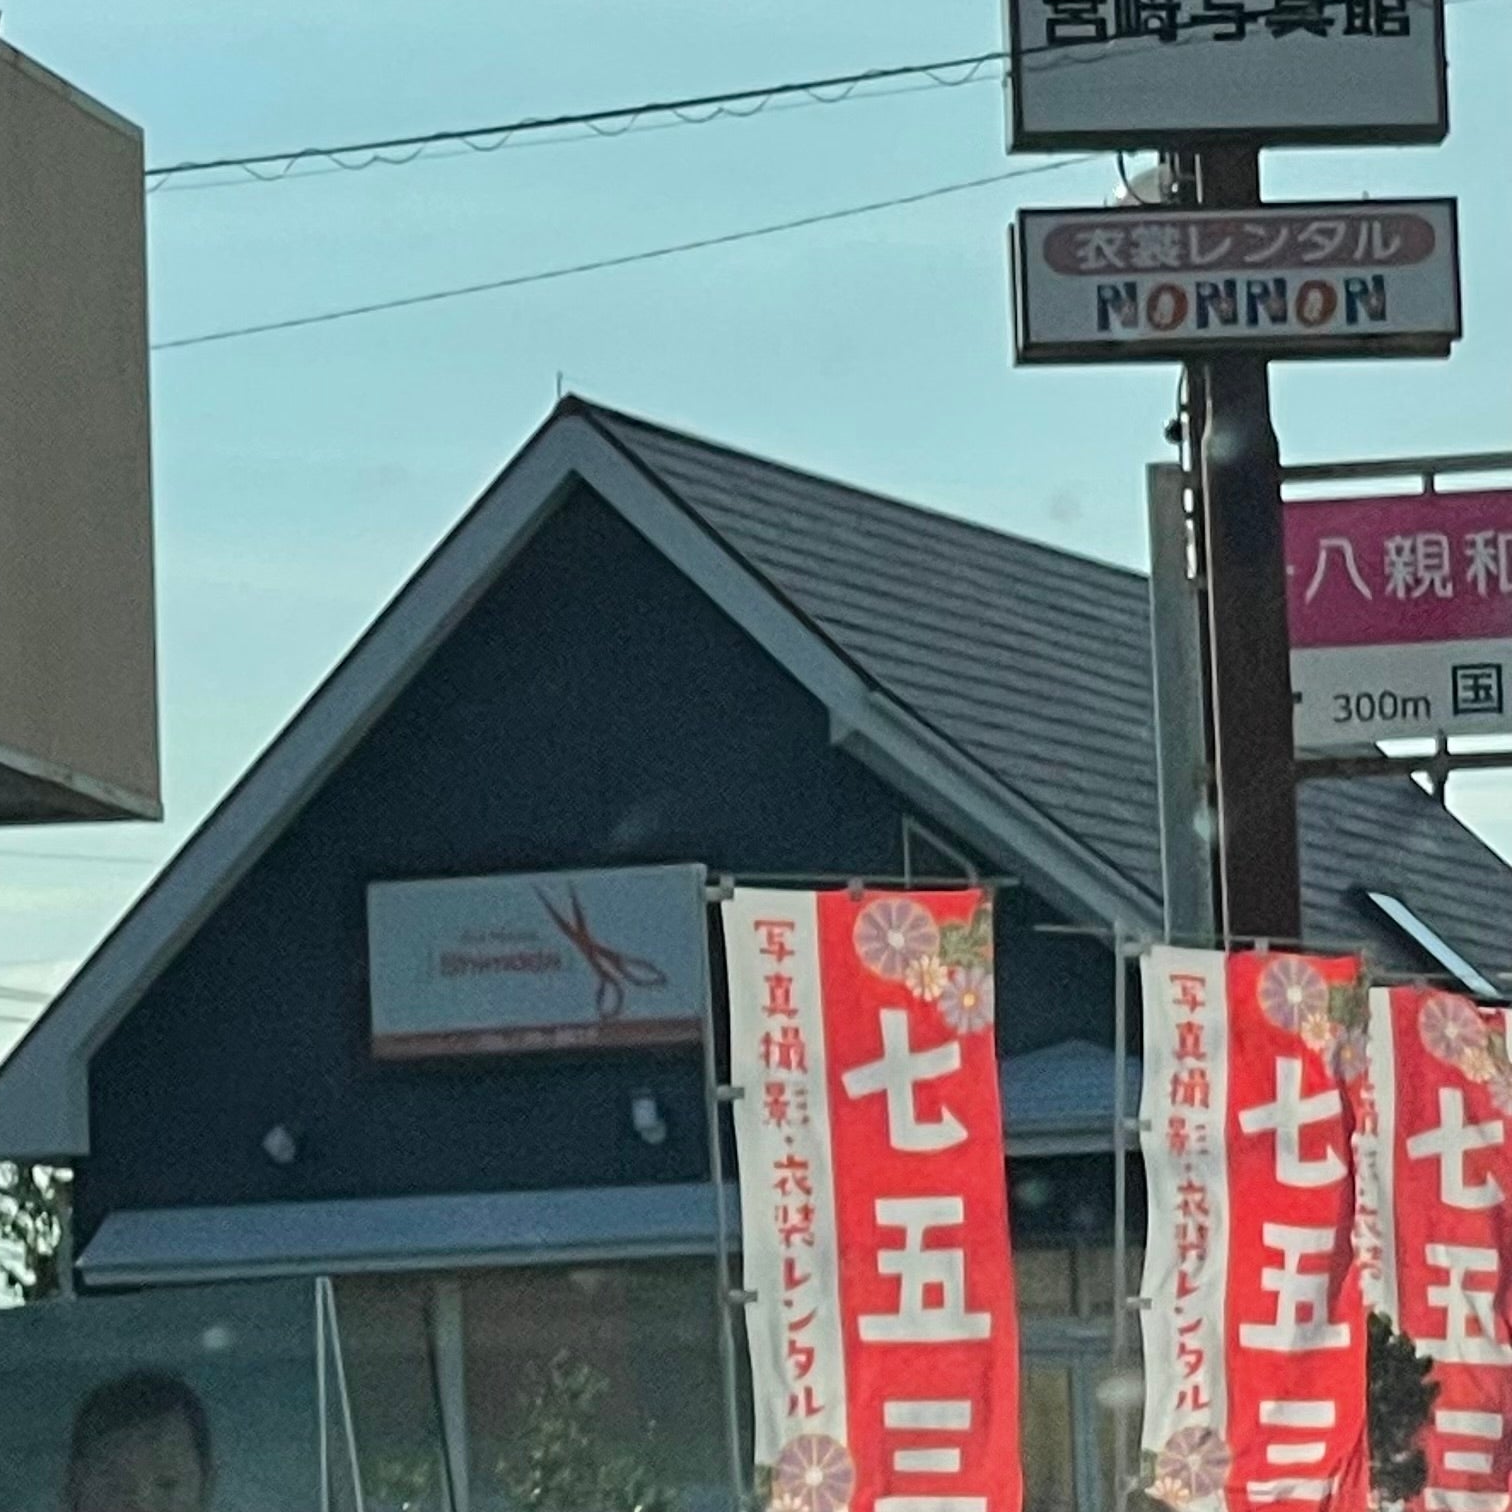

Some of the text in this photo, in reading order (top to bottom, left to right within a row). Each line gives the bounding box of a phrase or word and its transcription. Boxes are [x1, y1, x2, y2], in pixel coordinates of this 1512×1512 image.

[1096, 274, 1387, 333] NONNON
[1287, 530, 1512, 604] 八親和
[1332, 690, 1432, 723] 300m
[841, 1007, 992, 1512] 七五三
[1237, 1055, 1351, 1503] 七五三
[1405, 1086, 1512, 1512] 七五三
